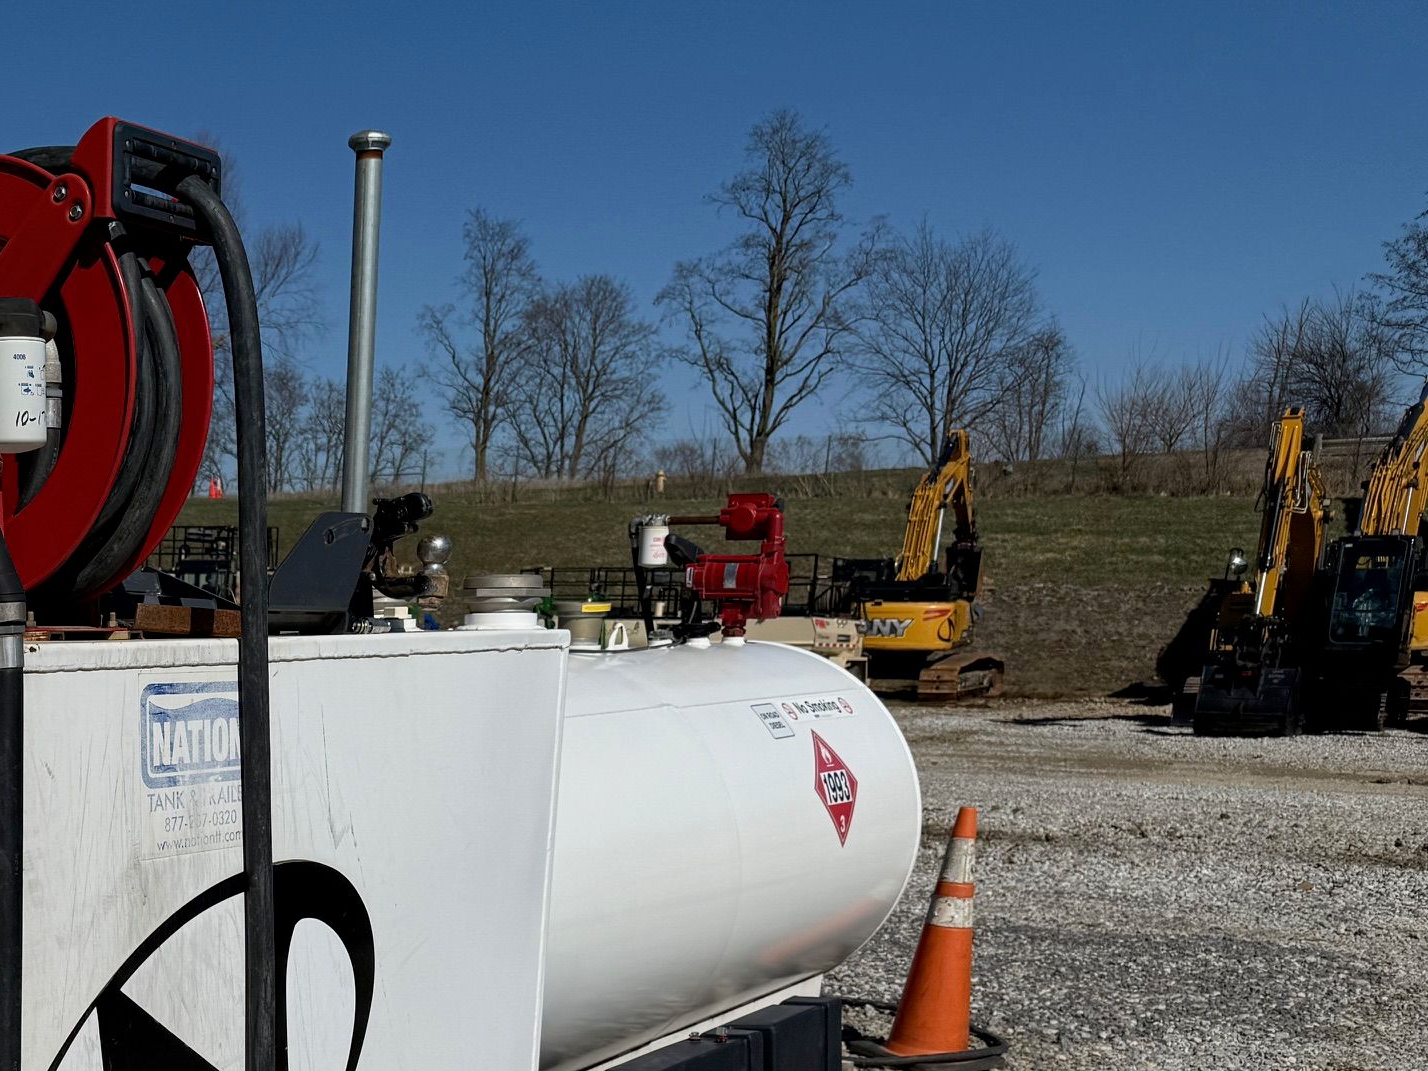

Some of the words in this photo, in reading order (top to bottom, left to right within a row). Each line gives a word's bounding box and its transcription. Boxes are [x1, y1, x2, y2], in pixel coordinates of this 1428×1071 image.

[792, 701, 809, 714] No
[804, 699, 842, 714] Smoking
[822, 771, 851, 804] 1993
[147, 790, 185, 813] TANK
[839, 814, 846, 833] 3
